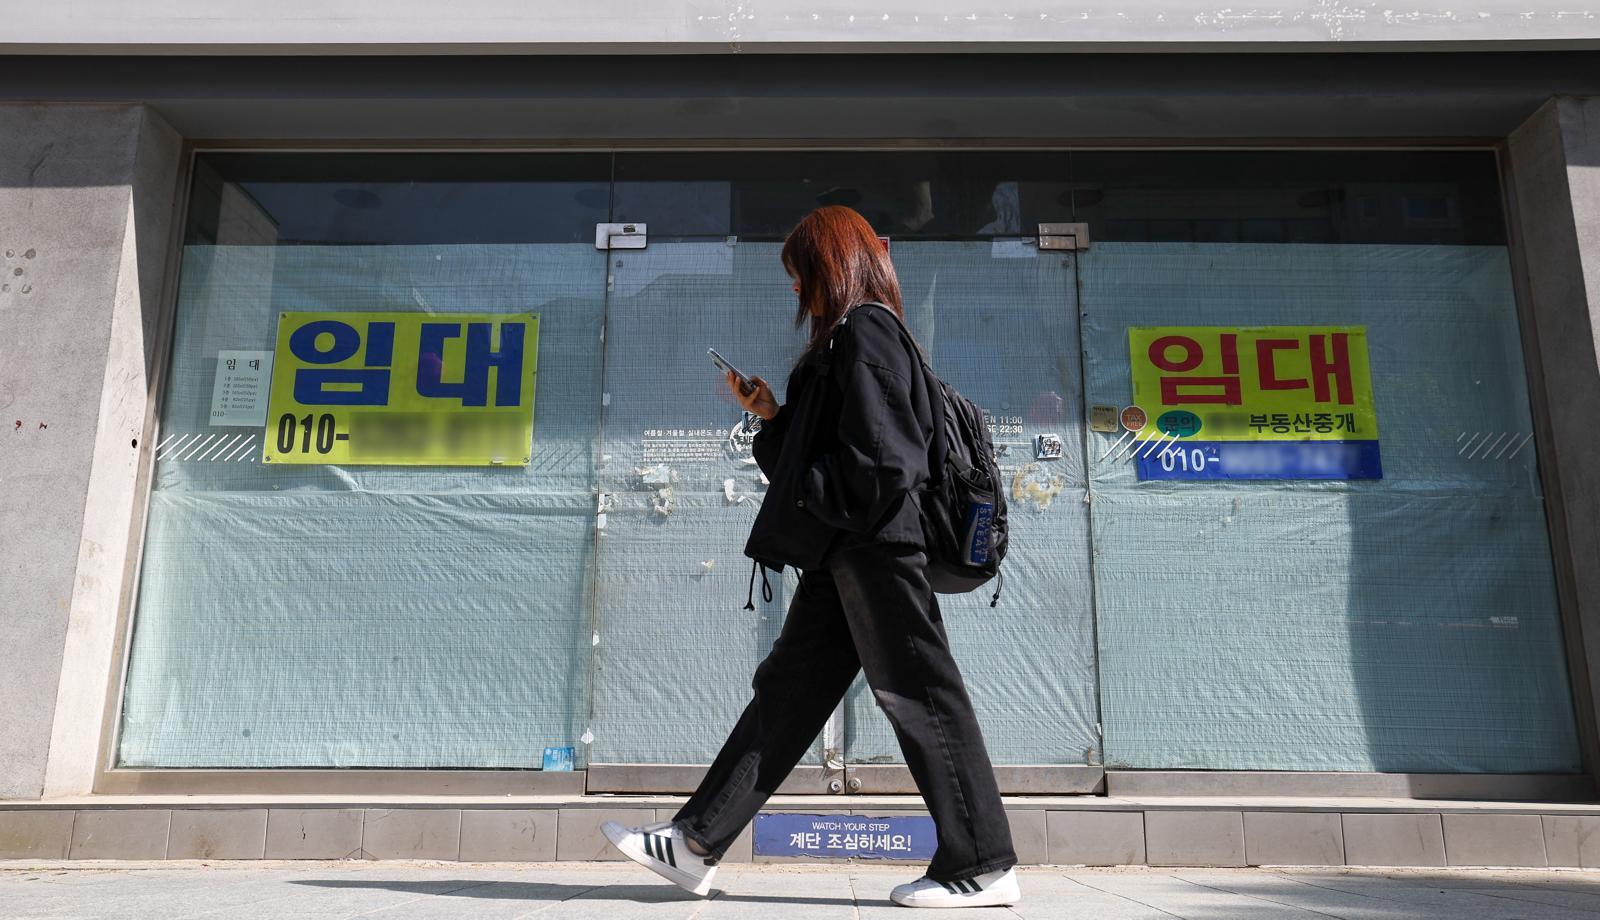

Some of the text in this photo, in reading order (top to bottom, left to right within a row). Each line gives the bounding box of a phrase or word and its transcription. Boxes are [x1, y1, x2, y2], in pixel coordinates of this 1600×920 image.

[289, 320, 525, 406] 임대
[1148, 333, 1354, 405] 임대
[984, 415, 1023, 424] EN 11:00
[999, 424, 1023, 433] 22:30
[1164, 415, 1196, 432] 문의
[1249, 413, 1356, 433] 부동산중개
[975, 507, 987, 556] SWEAT
[812, 822, 890, 832] WATCH YOUR STEP
[789, 832, 912, 851] 계단 조심하세요!
